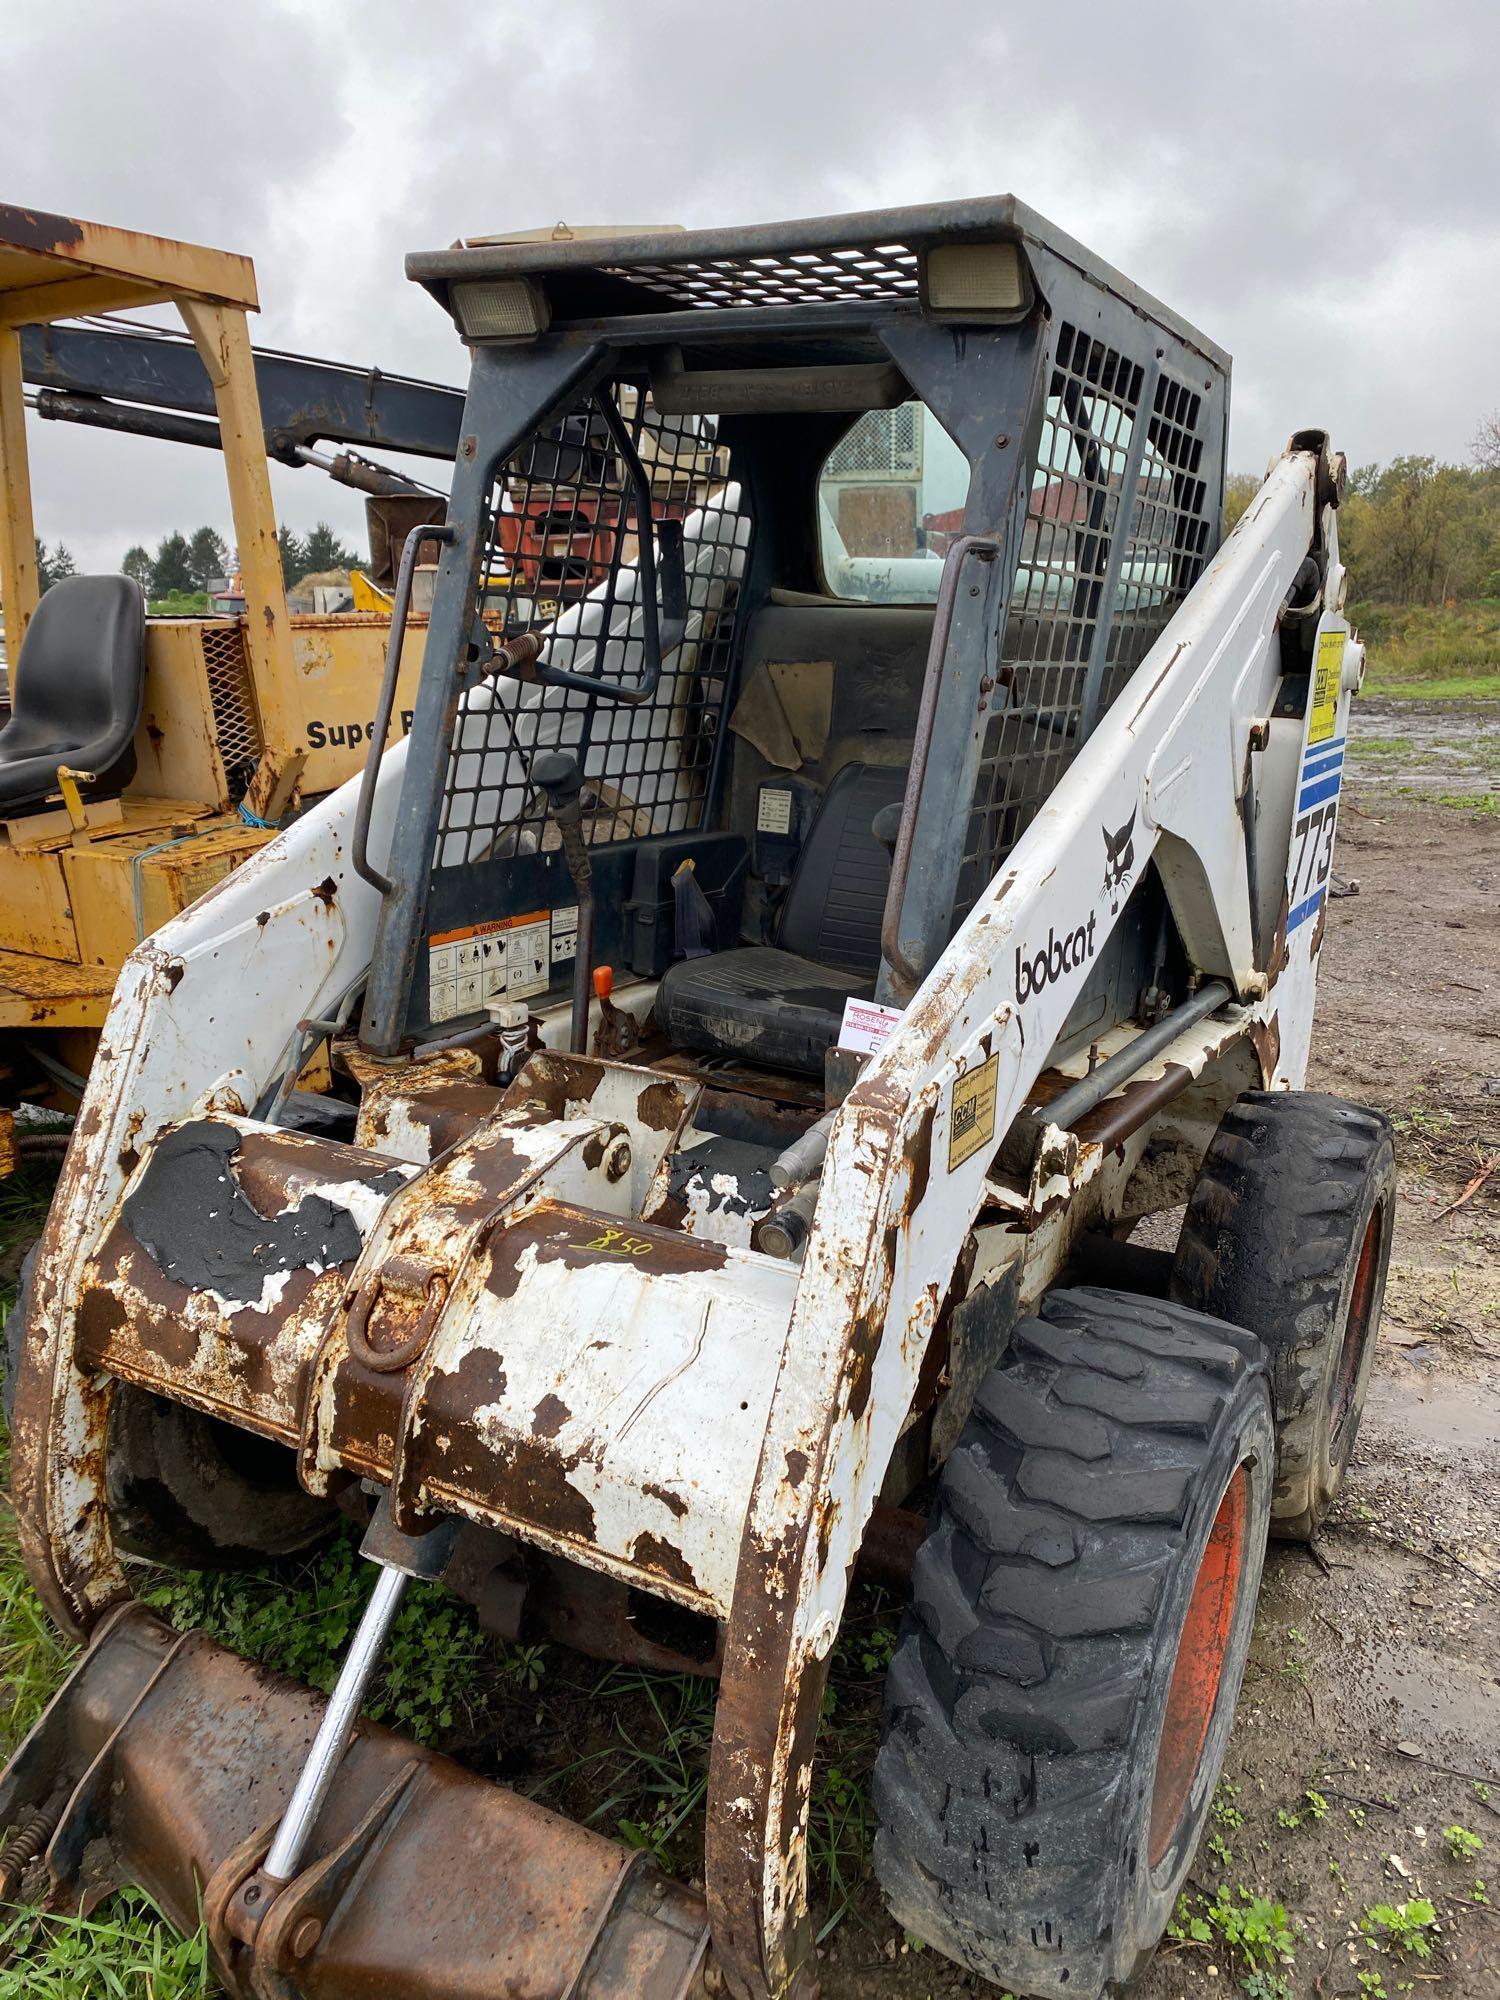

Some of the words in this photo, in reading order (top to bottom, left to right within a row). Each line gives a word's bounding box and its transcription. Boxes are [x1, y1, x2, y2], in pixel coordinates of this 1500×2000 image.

[306, 720, 391, 749] Supe
[1290, 801, 1336, 905] 773
[479, 919, 513, 935] WARNING
[1015, 909, 1096, 1005] bobcat
